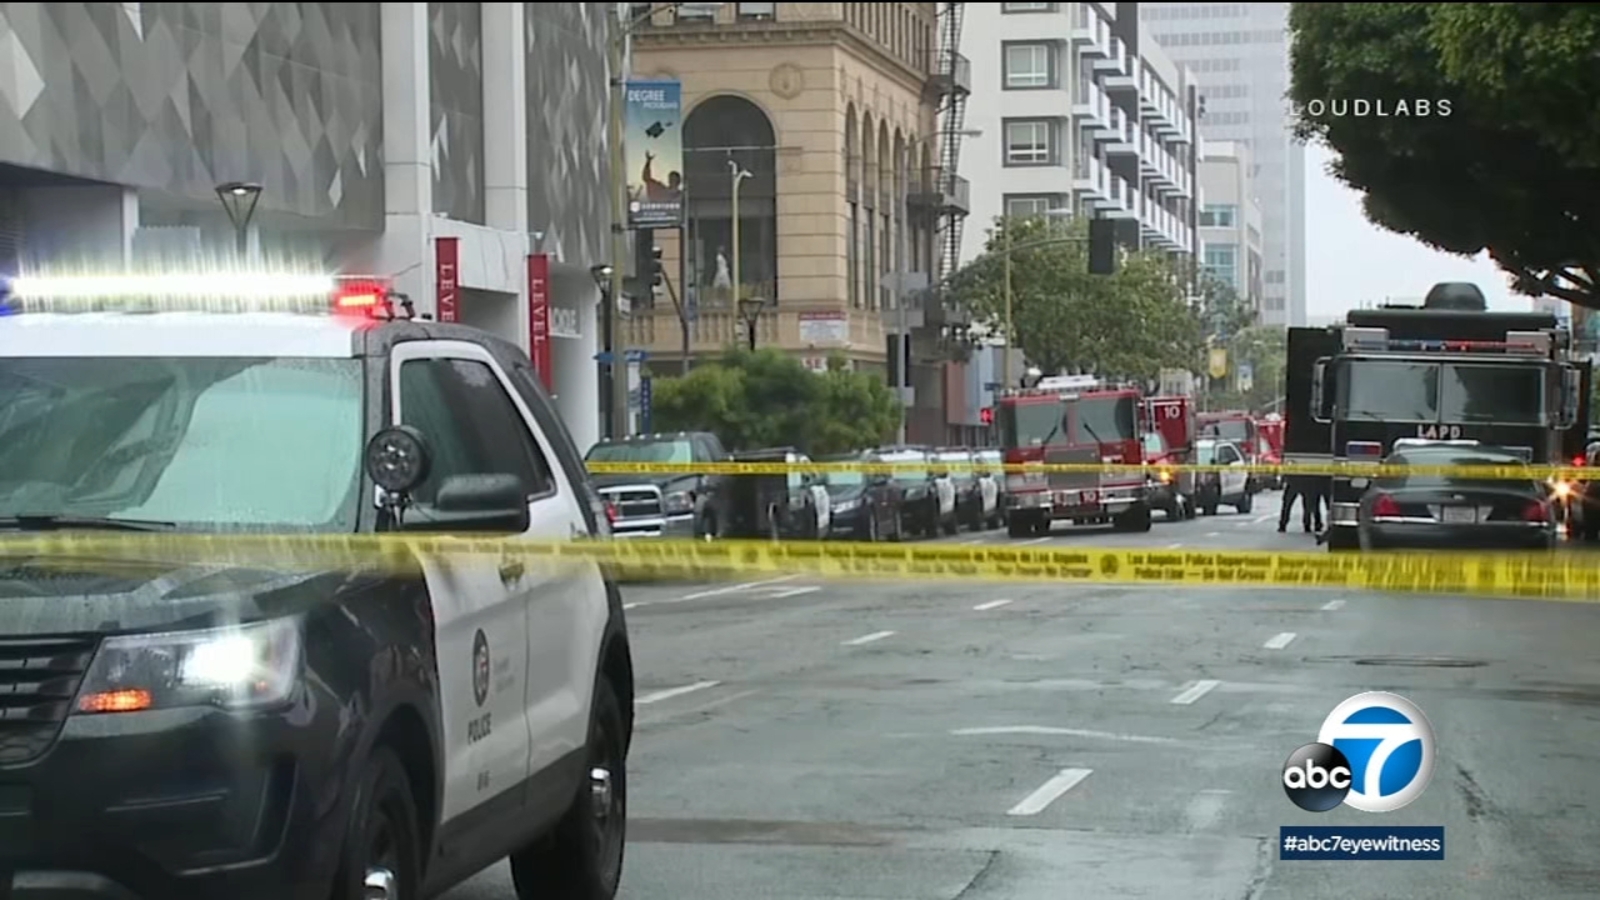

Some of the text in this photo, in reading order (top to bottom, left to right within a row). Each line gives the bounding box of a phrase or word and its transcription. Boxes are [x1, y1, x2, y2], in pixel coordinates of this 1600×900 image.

[627, 90, 665, 102] DEGREE
[440, 264, 455, 322] LEVE
[532, 279, 546, 345] LEVEL
[1164, 405, 1180, 419] 10
[1417, 424, 1461, 439] LAPD
[1127, 553, 1271, 567] Los Angeles Police Department
[1134, 568, 1162, 579] Police
[467, 712, 491, 745] POLICE
